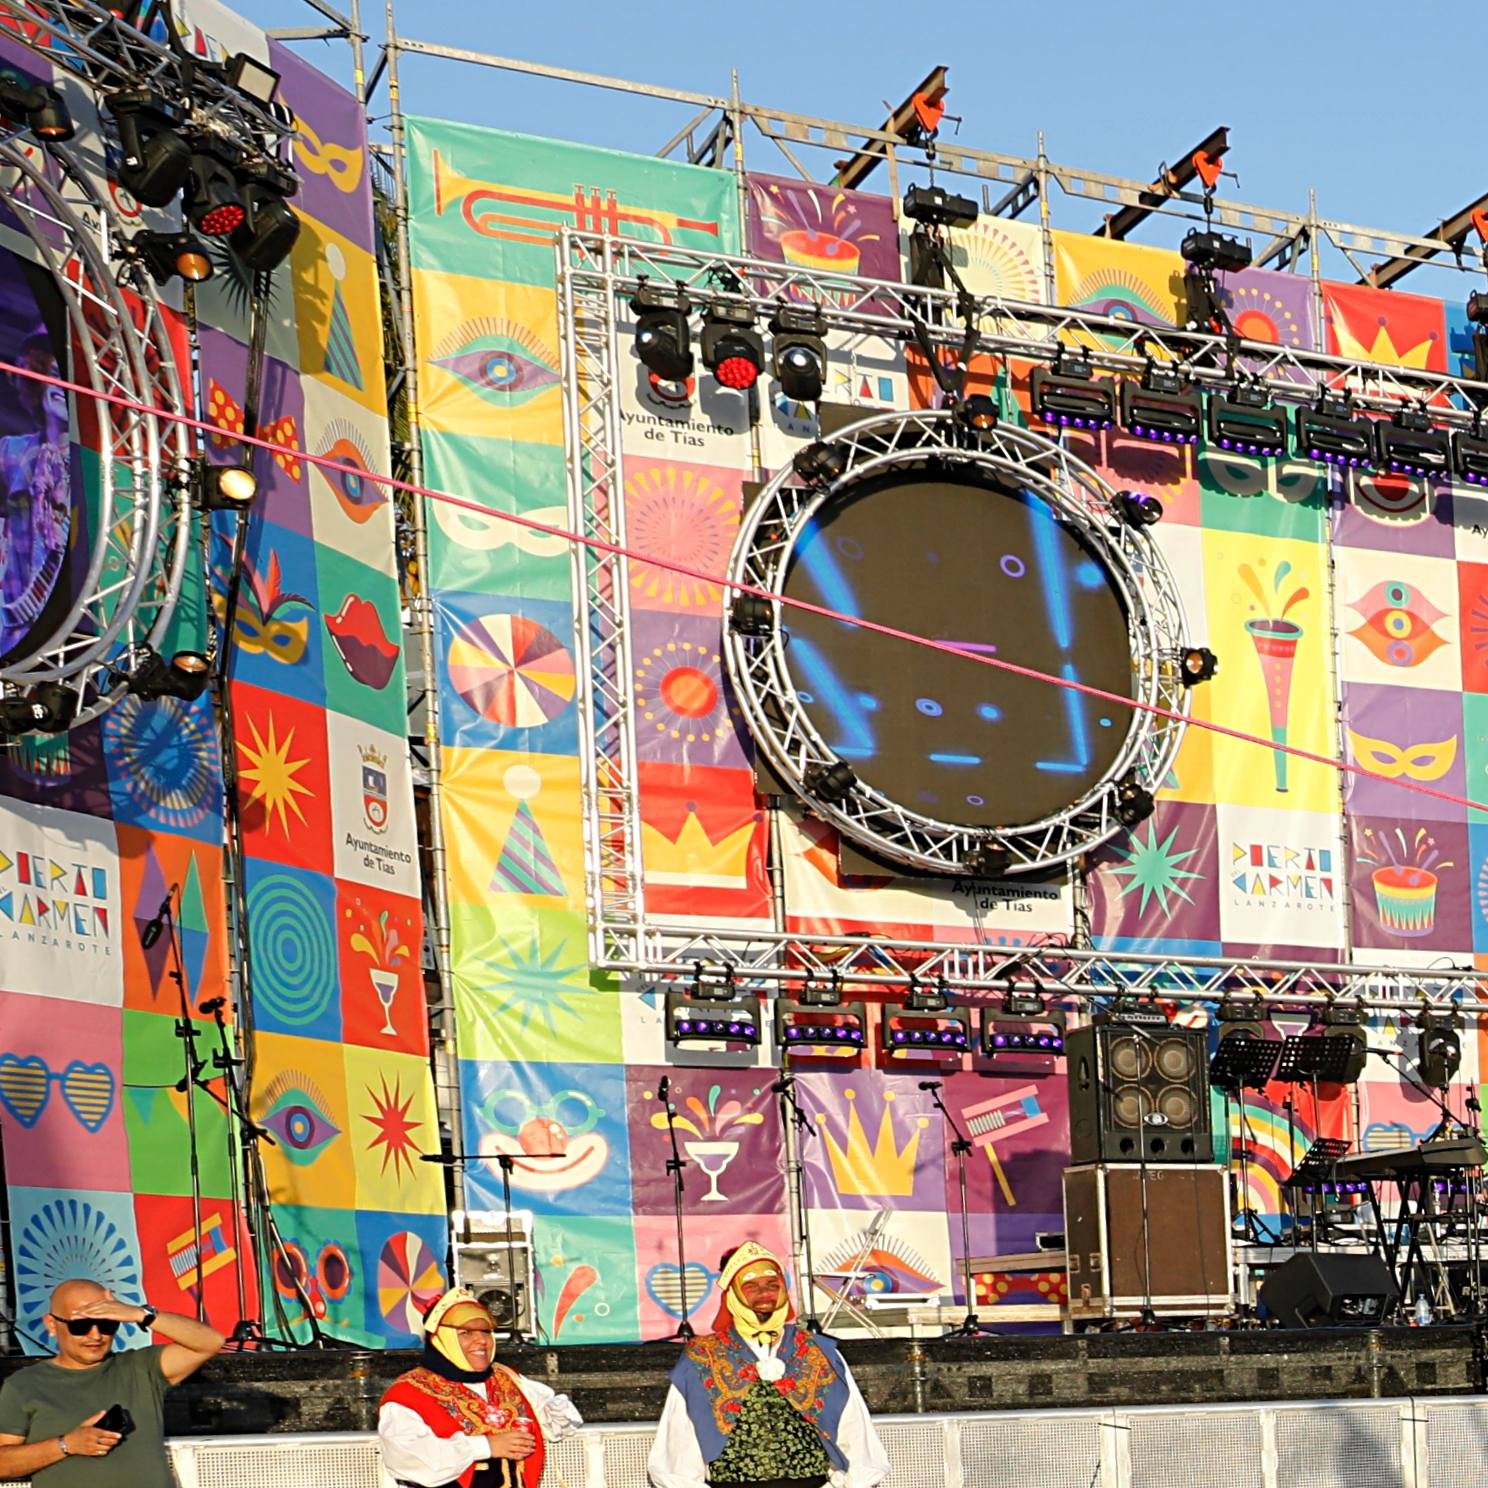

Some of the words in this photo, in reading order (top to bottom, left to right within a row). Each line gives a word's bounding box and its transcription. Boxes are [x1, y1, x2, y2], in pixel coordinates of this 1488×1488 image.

[644, 428, 665, 441] de
[345, 832, 411, 863] Ayuntamiento
[363, 854, 375, 868] de
[952, 881, 1058, 900] Ayuntamiento
[980, 898, 997, 909] de
